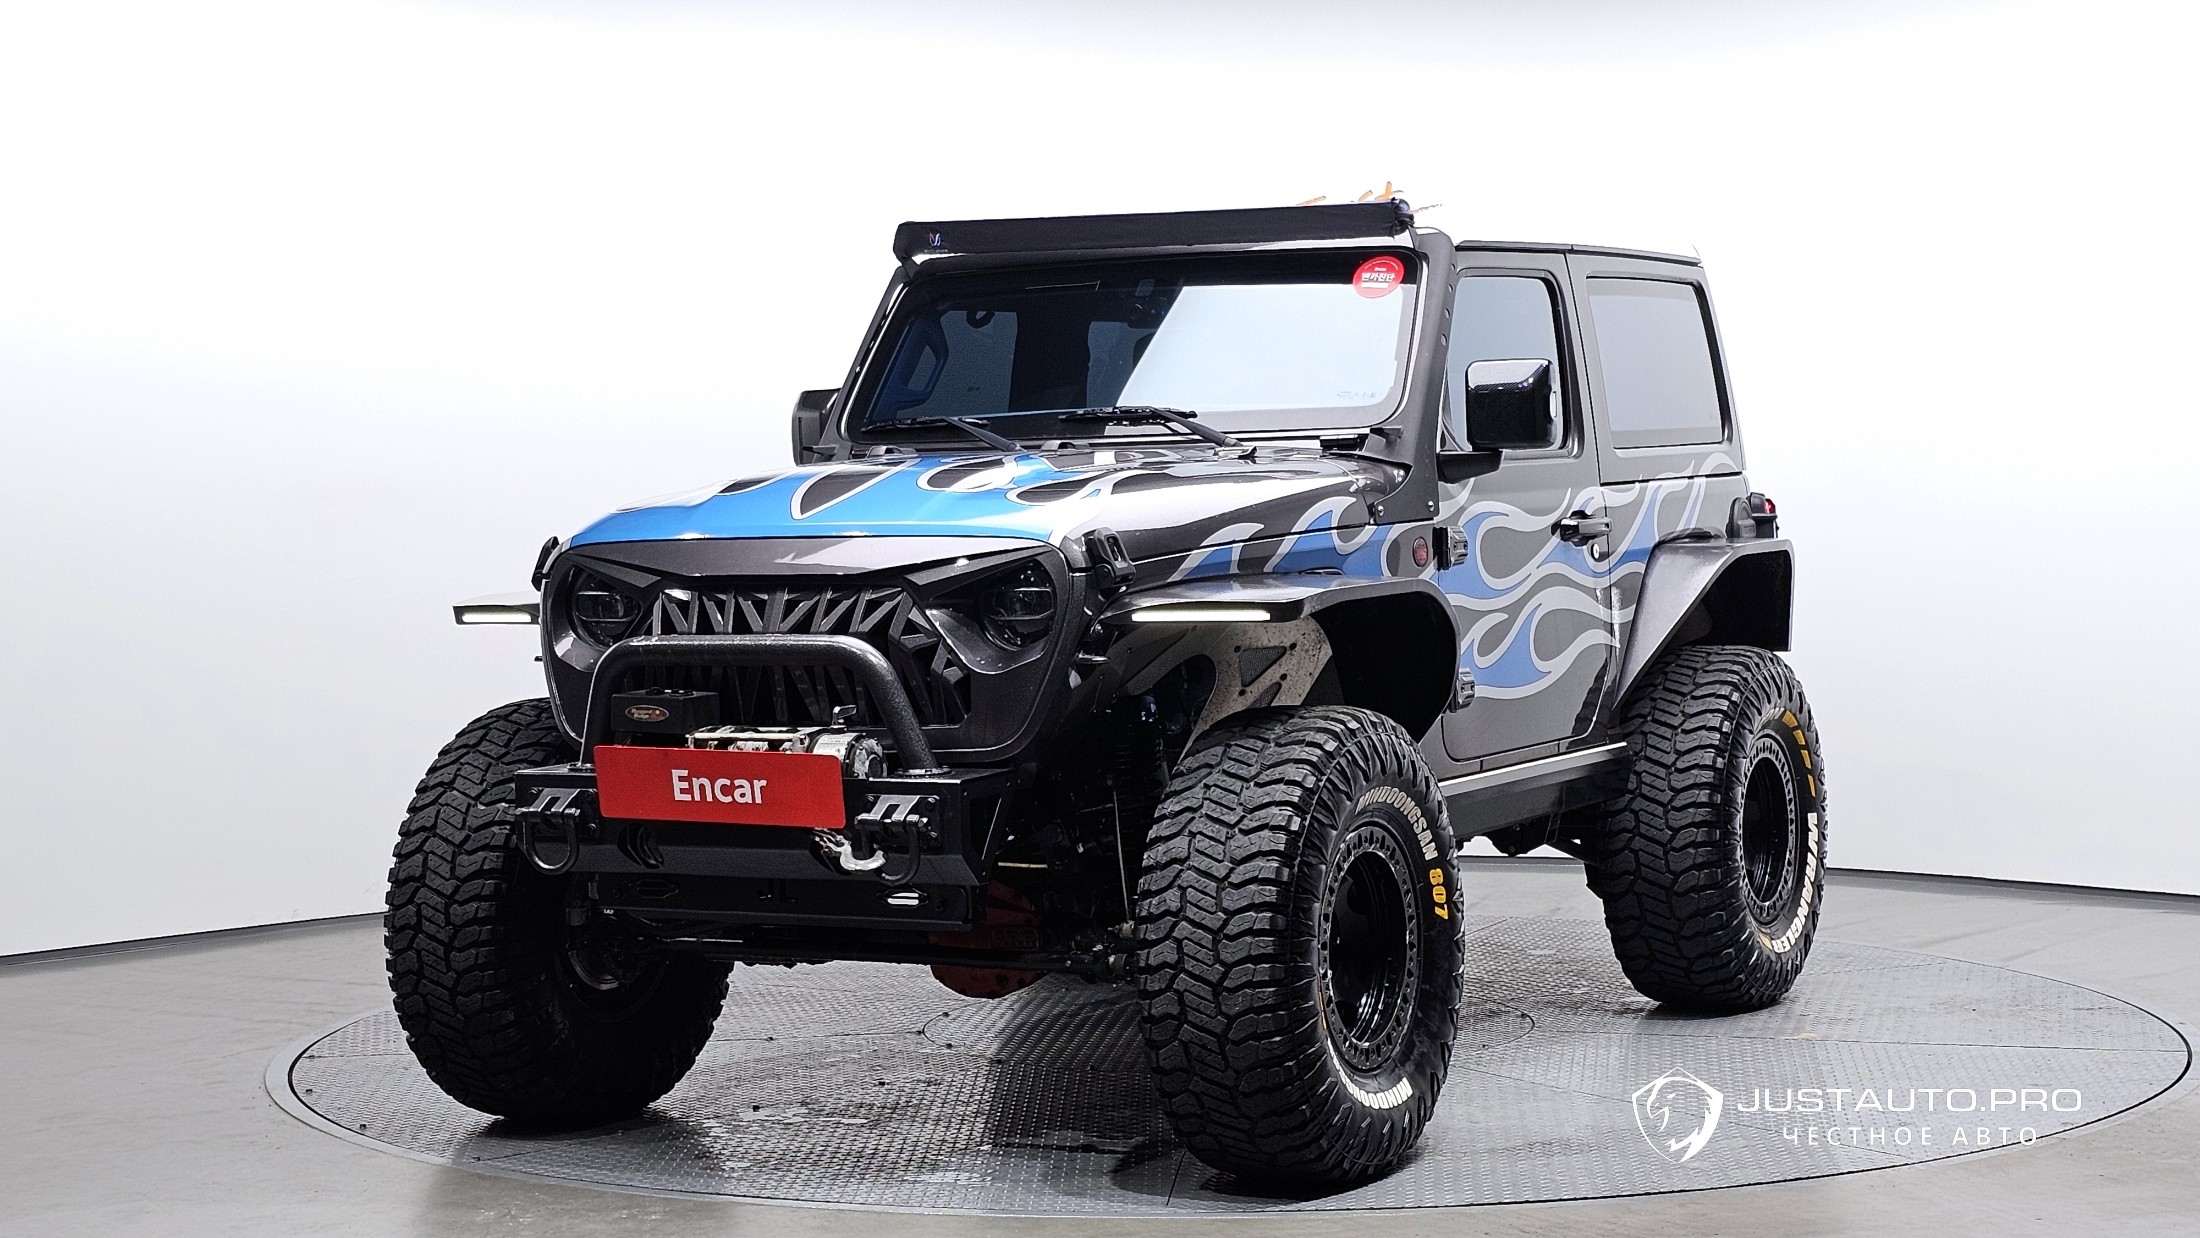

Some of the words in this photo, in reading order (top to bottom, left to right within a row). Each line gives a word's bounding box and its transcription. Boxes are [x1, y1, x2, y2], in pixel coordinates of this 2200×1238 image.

[671, 769, 768, 804] Encar
[1355, 786, 1438, 861] MINDOONGSAN
[1429, 868, 1449, 920] 807
[1771, 812, 1818, 954] WRANGLER
